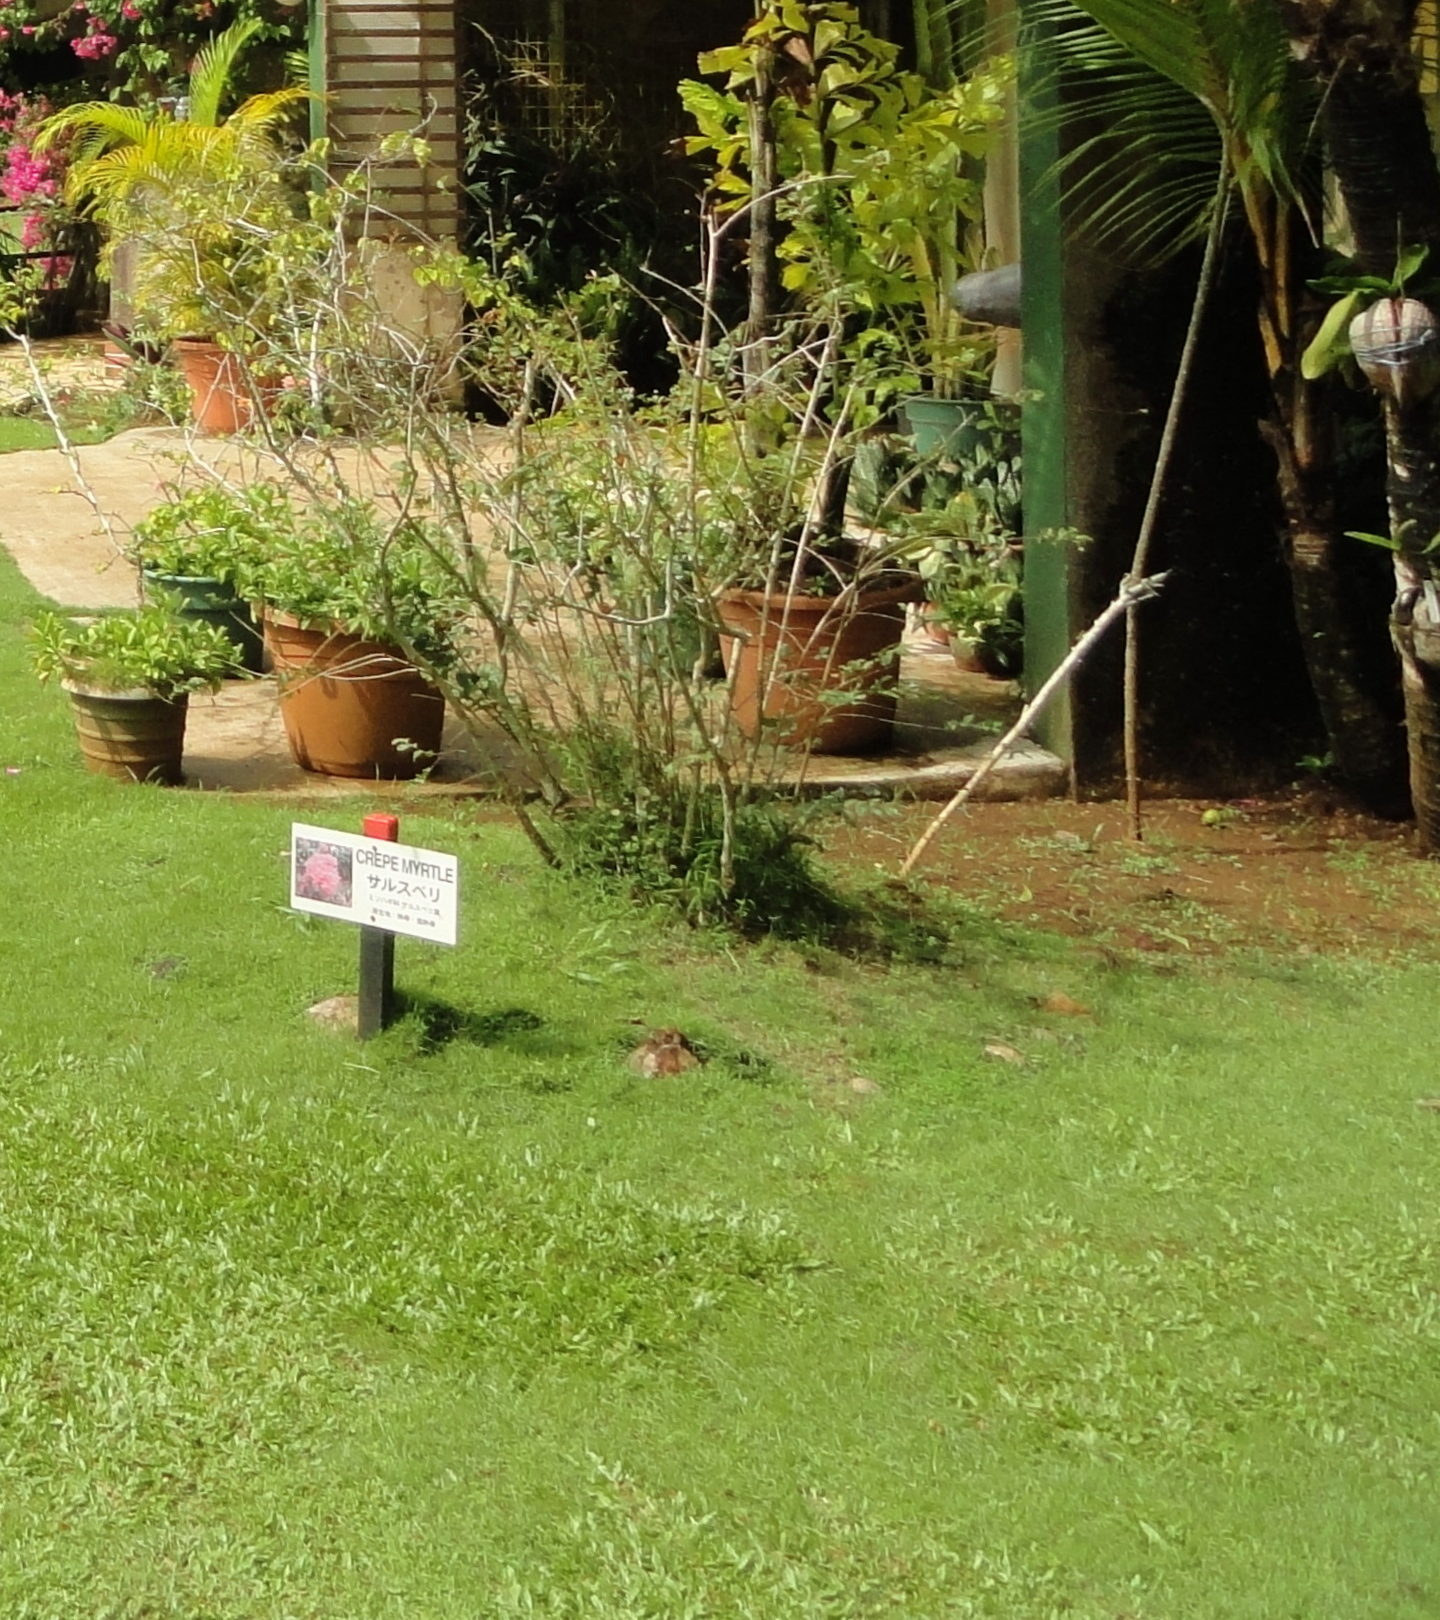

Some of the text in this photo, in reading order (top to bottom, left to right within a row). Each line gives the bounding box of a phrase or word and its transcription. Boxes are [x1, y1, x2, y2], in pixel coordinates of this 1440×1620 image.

[355, 848, 454, 884] CREPE MYRTLE
[367, 873, 441, 904] サルスベリ
